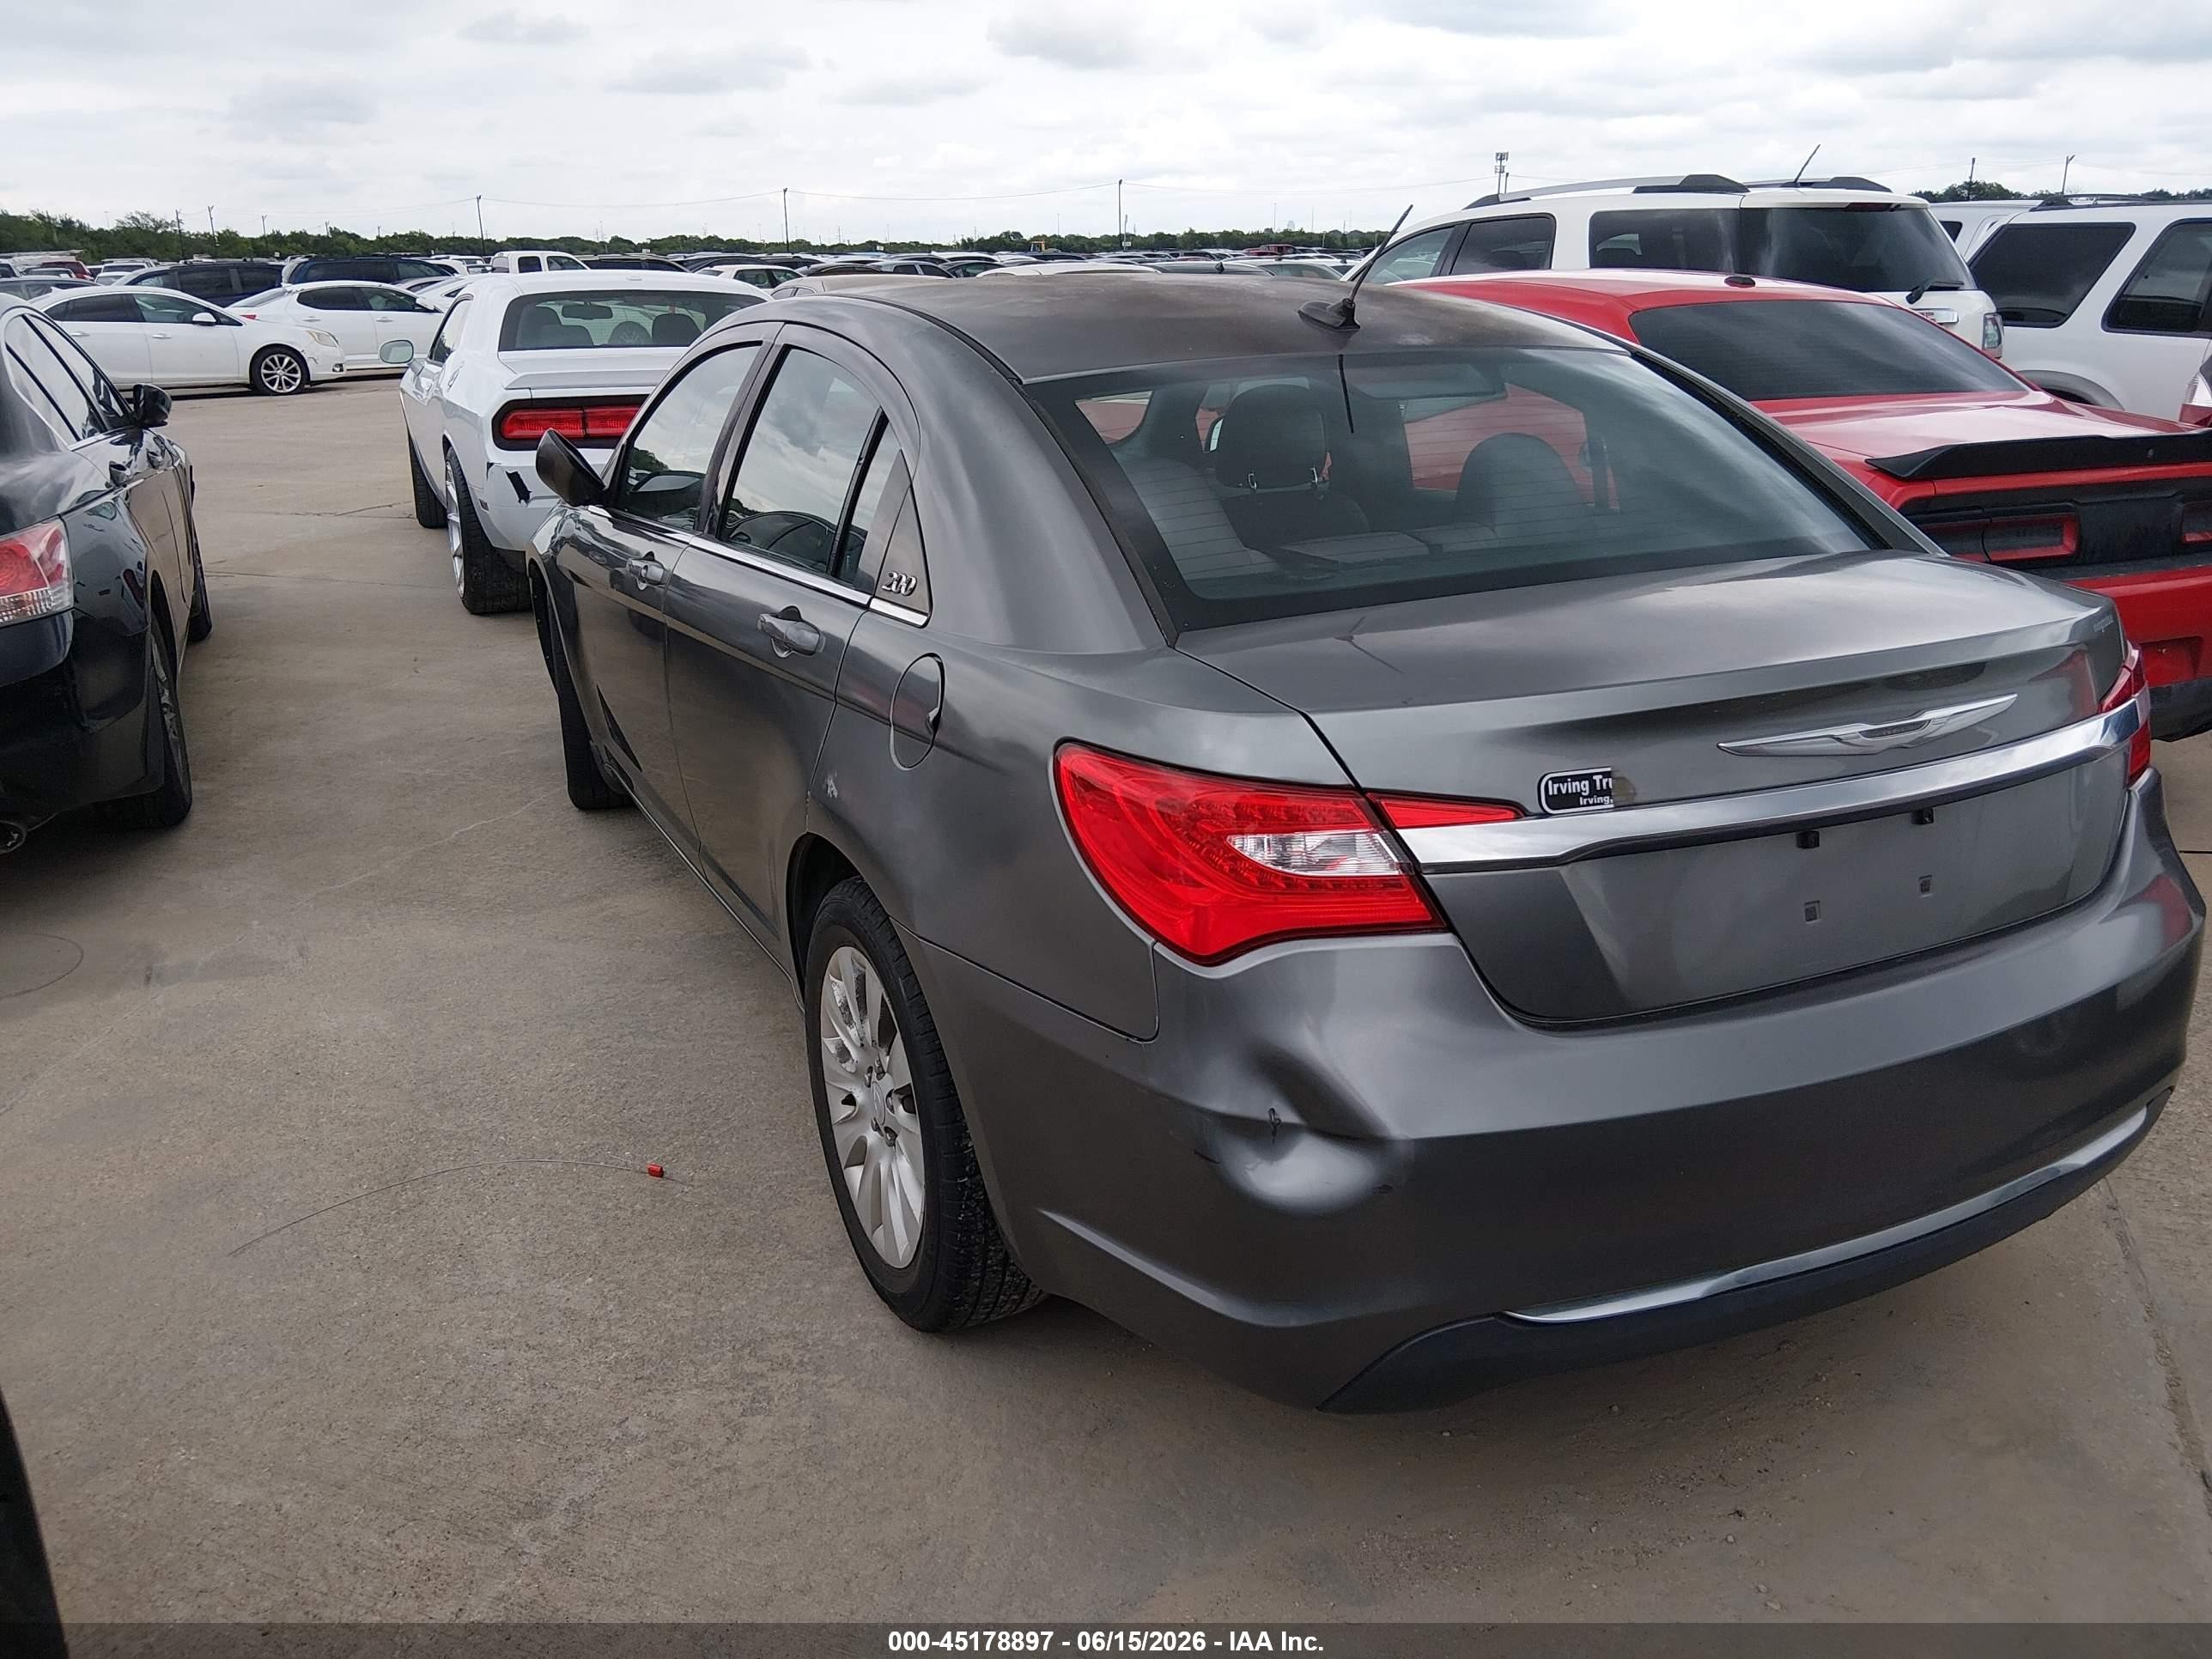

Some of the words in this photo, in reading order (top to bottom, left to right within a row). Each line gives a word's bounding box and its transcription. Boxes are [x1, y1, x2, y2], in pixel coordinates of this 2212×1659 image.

[881, 571, 918, 597] 200
[1547, 778, 1589, 796] Irving
[1579, 794, 1613, 805] Irving,
